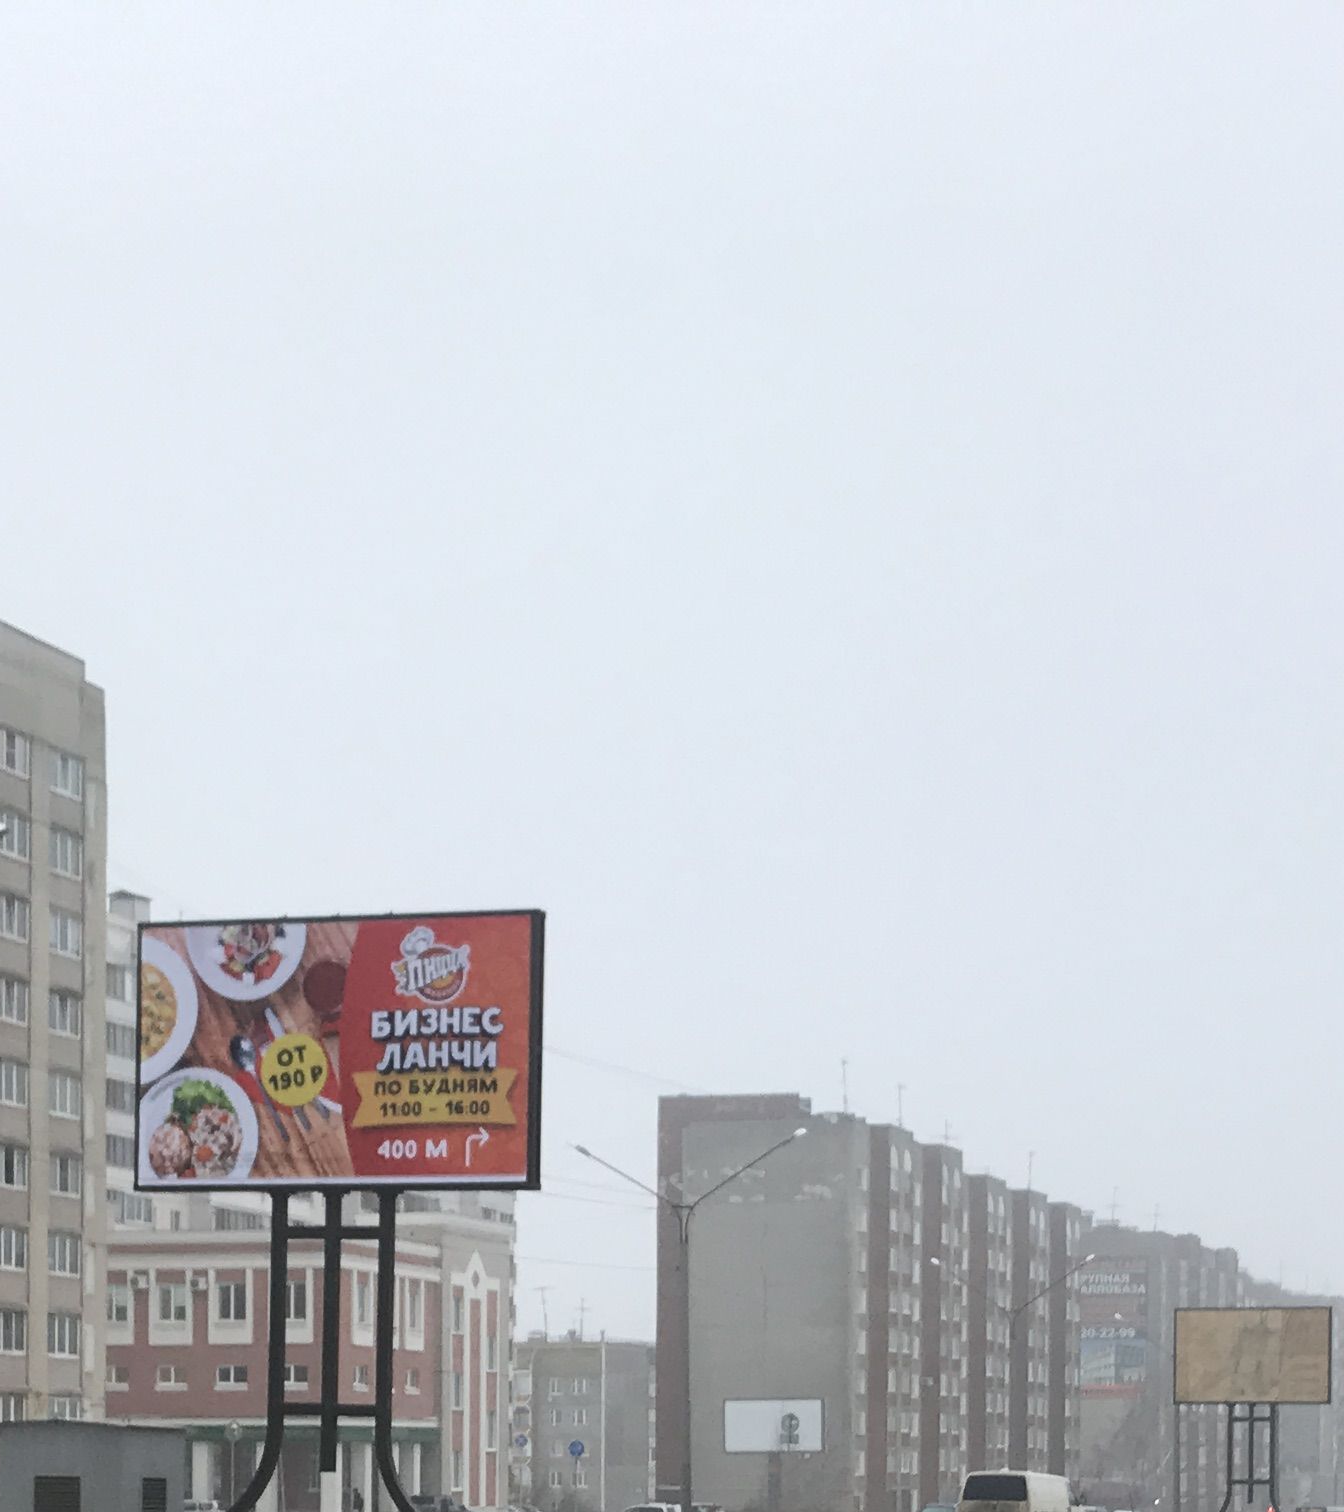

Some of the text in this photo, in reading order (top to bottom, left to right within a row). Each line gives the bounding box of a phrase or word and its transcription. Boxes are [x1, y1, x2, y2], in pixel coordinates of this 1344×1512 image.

[371, 1007, 504, 1039] БИЗНЕС
[277, 1045, 306, 1067] ОТ
[376, 1040, 497, 1072] ЛАНЧИ
[269, 1069, 305, 1091] 190
[374, 1079, 498, 1095] ПО БУДНЯМ
[380, 1101, 422, 1117] 11:00
[377, 1139, 448, 1159] 400 М
